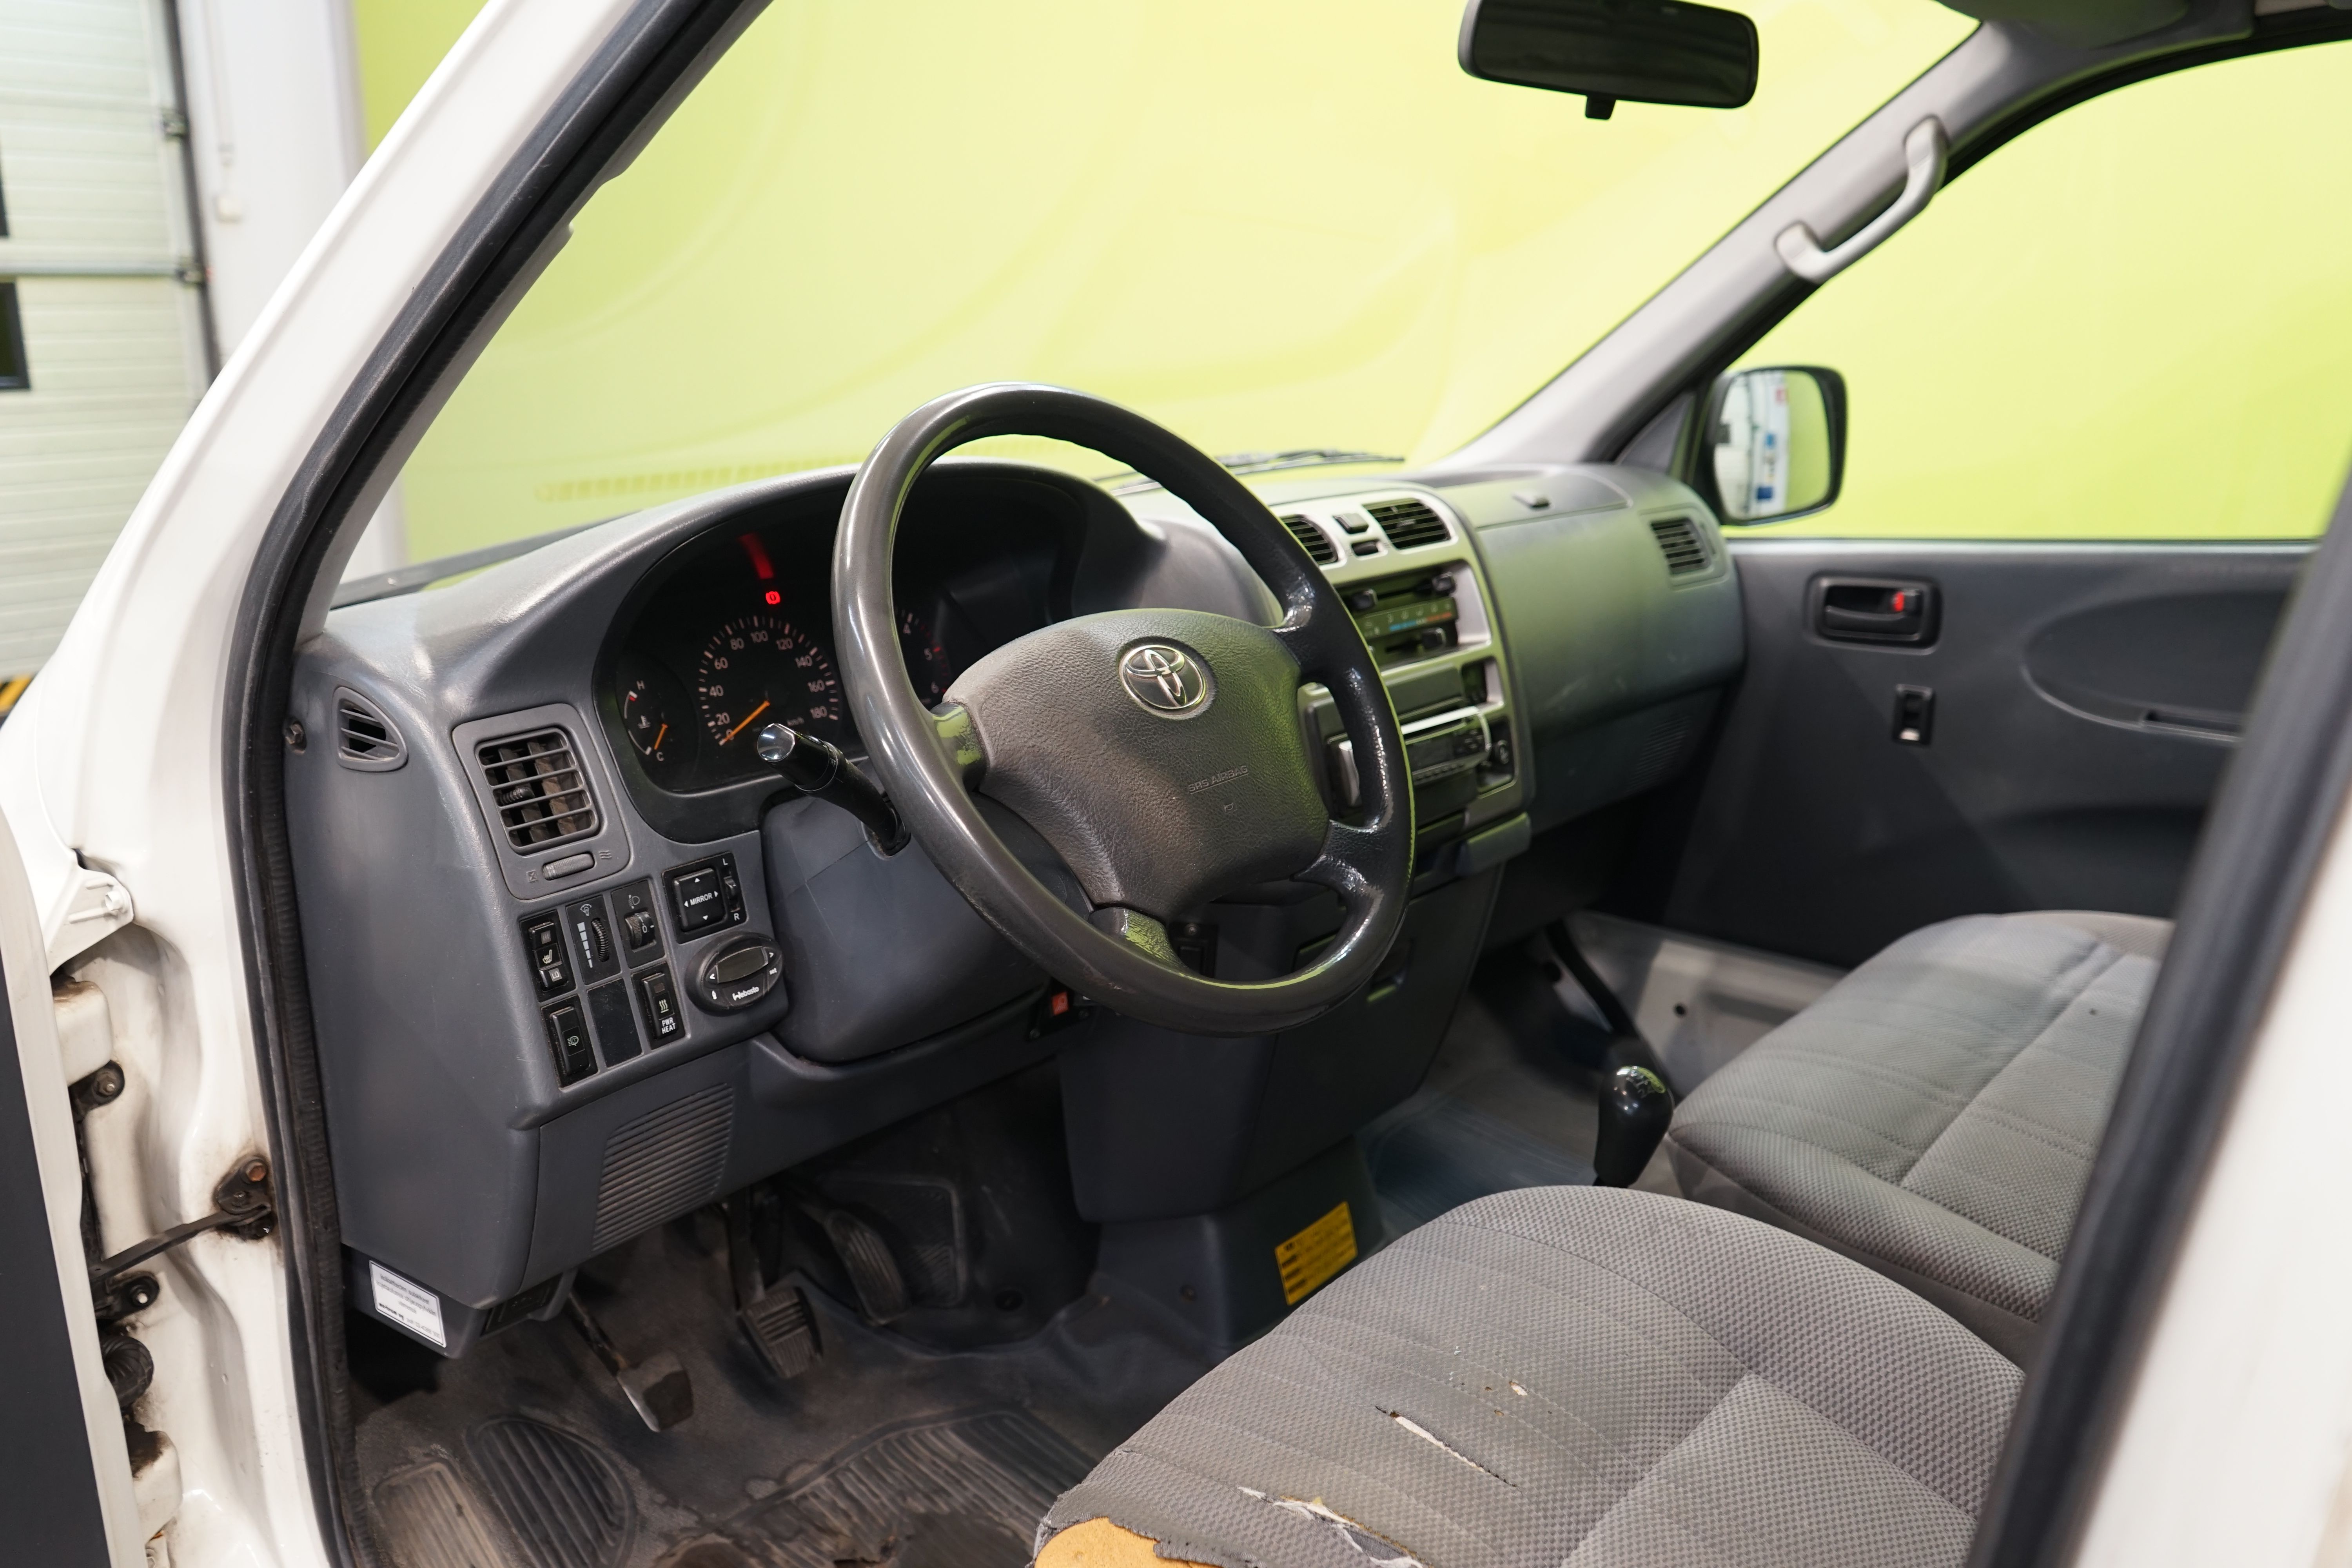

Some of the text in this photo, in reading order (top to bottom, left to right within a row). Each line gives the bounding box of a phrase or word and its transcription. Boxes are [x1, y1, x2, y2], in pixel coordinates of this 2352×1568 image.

[750, 630, 768, 643] 100
[730, 637, 744, 650] 80
[775, 637, 793, 650] 120
[924, 647, 933, 661] 5
[714, 657, 729, 670] 60
[795, 655, 813, 668] 140
[636, 680, 645, 690] H
[709, 684, 724, 697] 40
[807, 679, 825, 693] 160
[930, 681, 939, 693] 6
[715, 712, 730, 725] 20
[809, 706, 827, 719] 180
[656, 751, 665, 762] C
[1189, 765, 1248, 792] SRS AIRBAG
[690, 892, 713, 906] MIRROR
[733, 913, 740, 921] R
[732, 986, 760, 1001] Webasto
[661, 1017, 674, 1027] PWR
[661, 1023, 676, 1034] HEAT
